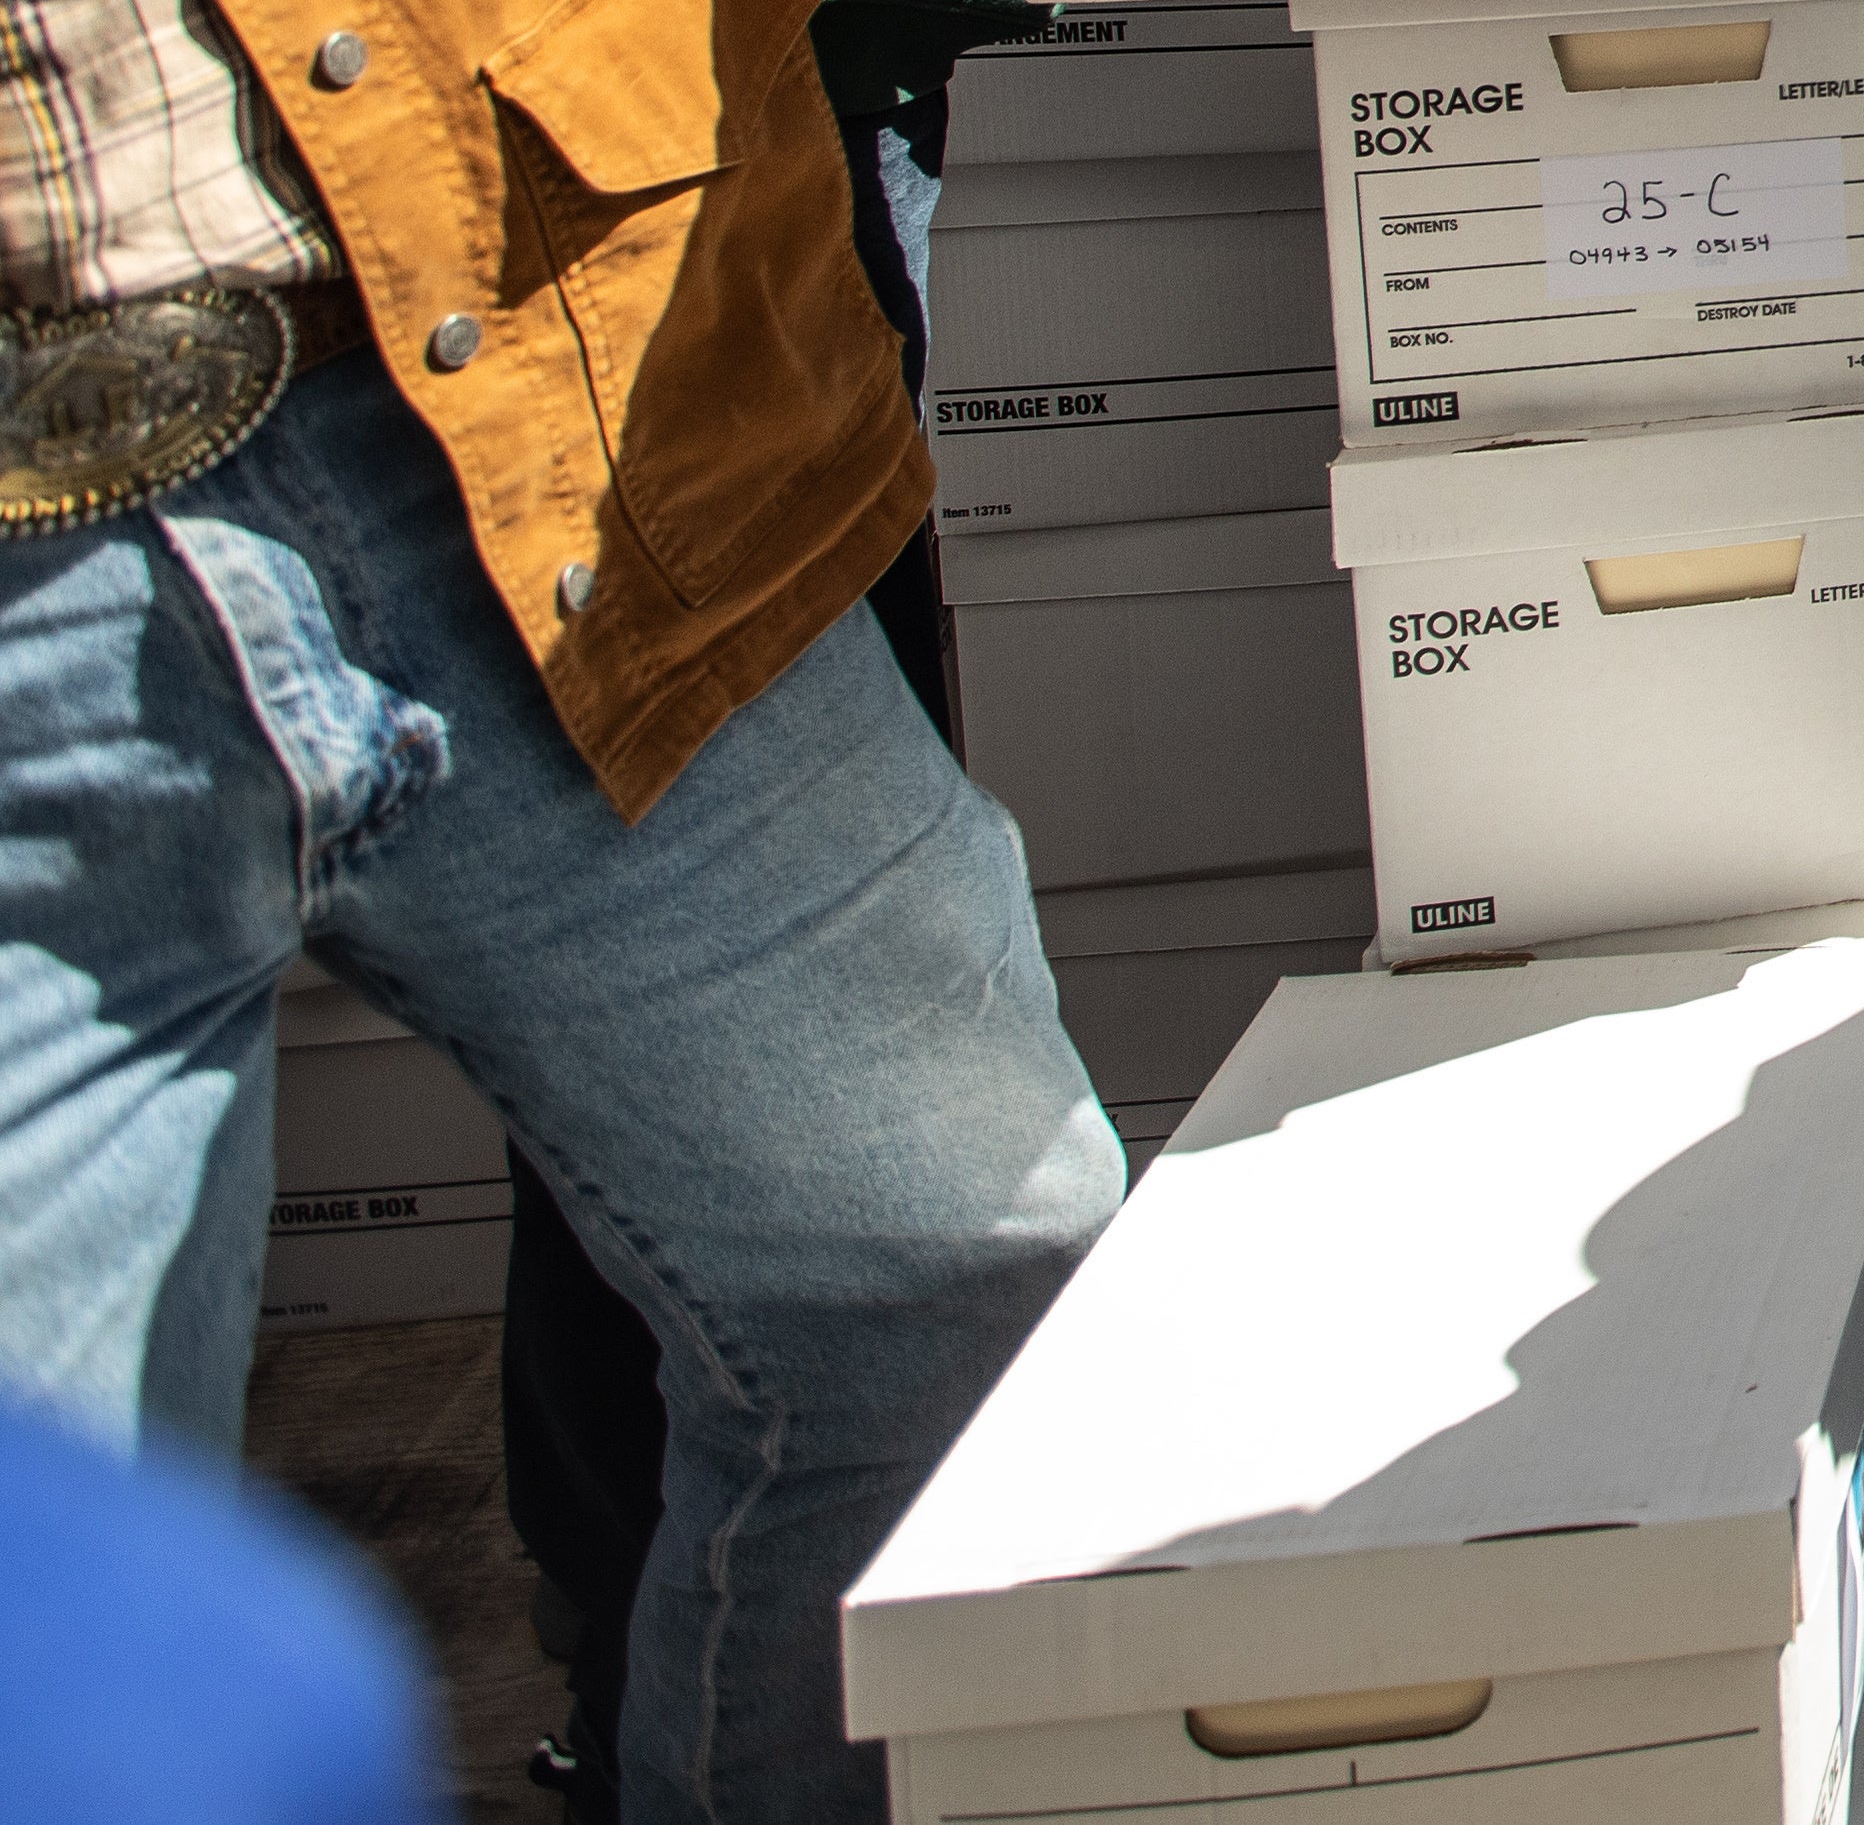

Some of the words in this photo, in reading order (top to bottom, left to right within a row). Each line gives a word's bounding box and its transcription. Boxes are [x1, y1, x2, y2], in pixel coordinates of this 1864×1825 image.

[1350, 82, 1525, 122] STORAGE
[1354, 125, 1434, 158] BOX
[1381, 218, 1459, 237] CONTENTS
[1569, 245, 1649, 266] 04943
[1385, 276, 1430, 293] FROM
[1697, 304, 1759, 323] DESTROY
[1761, 301, 1797, 317] DATE
[1389, 333, 1422, 349] BOX
[1424, 331, 1454, 347] NO.
[936, 396, 1050, 424] STORAGE
[1057, 392, 1109, 417] BOX
[1378, 396, 1455, 422] ULINE
[972, 503, 1013, 517] 13715
[1388, 600, 1561, 644] STORAGE
[1391, 643, 1472, 678] BOX
[1416, 900, 1493, 928] ULINE
[367, 1195, 421, 1219] BOX
